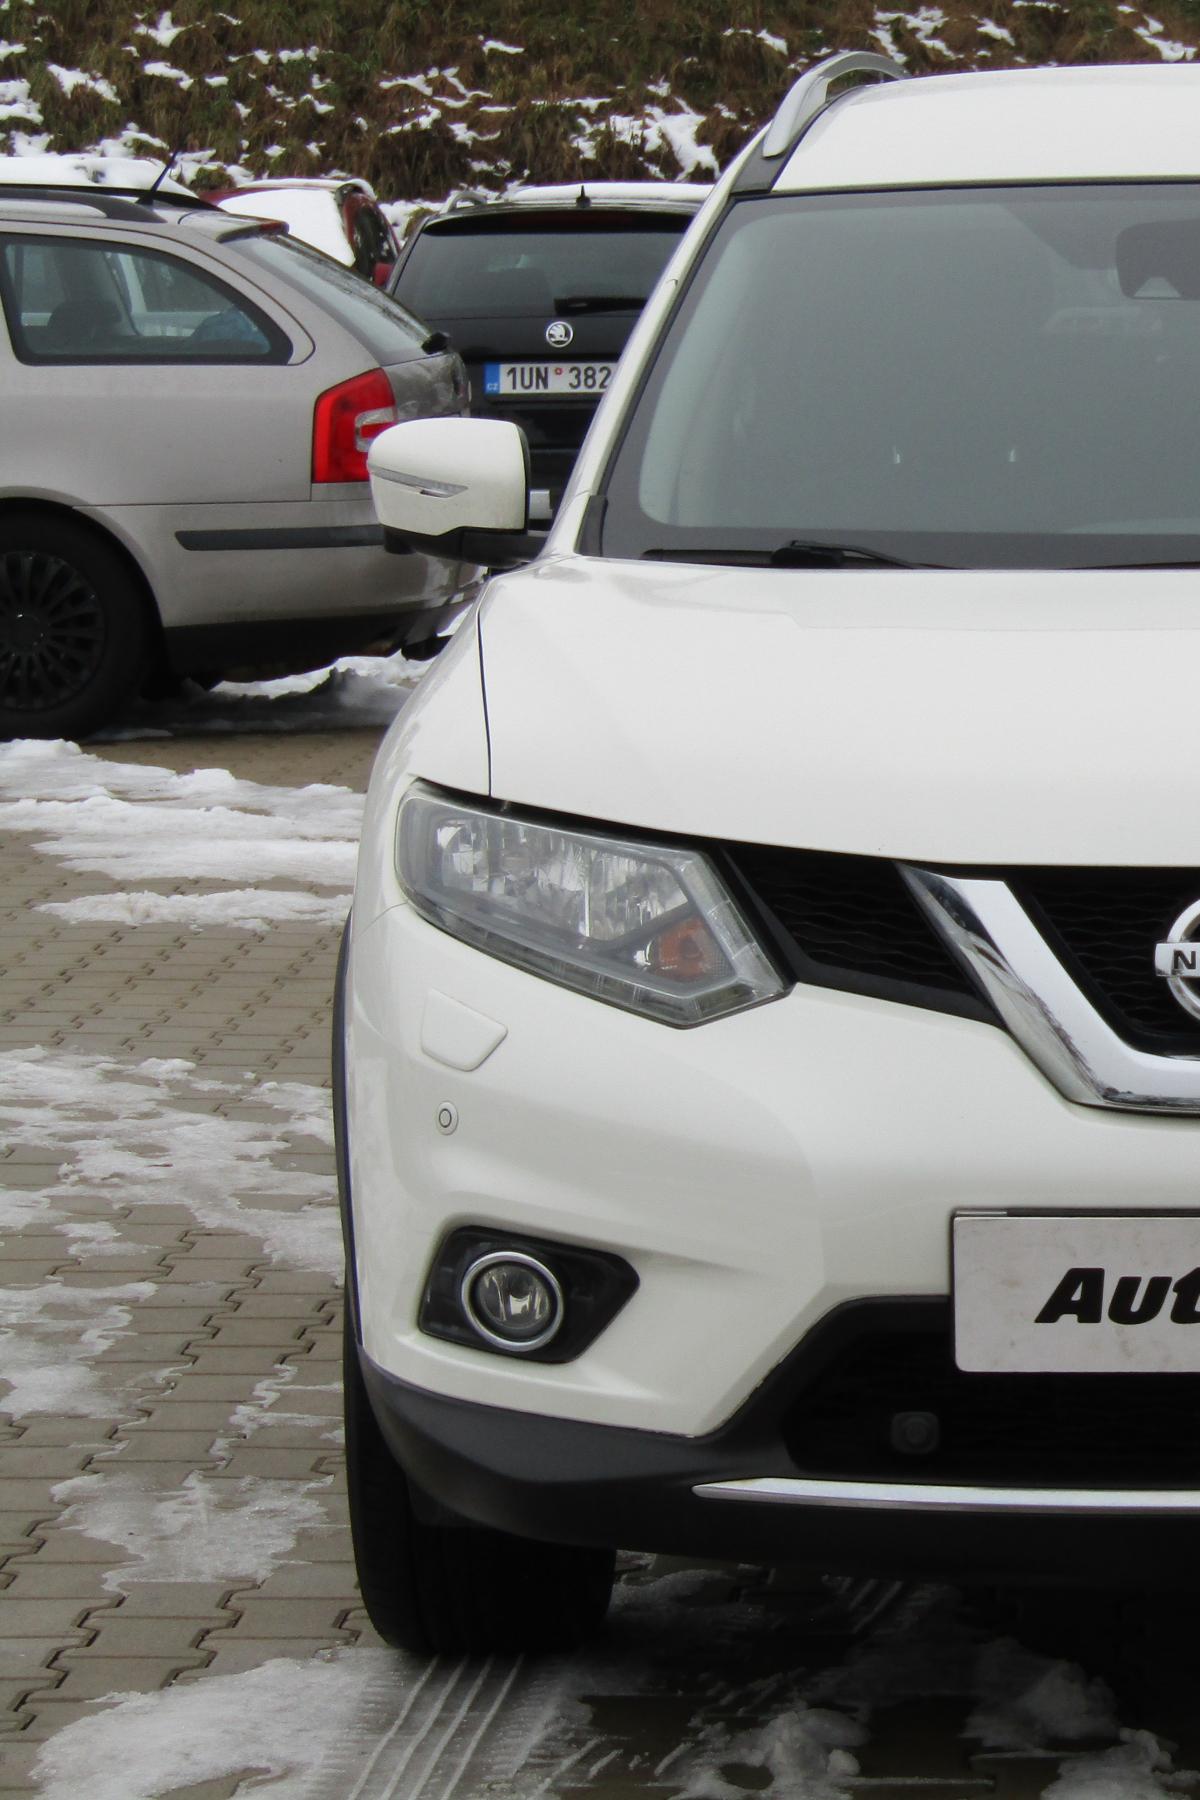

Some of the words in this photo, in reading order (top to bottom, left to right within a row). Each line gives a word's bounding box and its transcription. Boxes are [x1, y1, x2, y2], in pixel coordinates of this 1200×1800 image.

[486, 382, 499, 391] CZ
[506, 366, 549, 391] 1UN
[568, 366, 612, 390] 382
